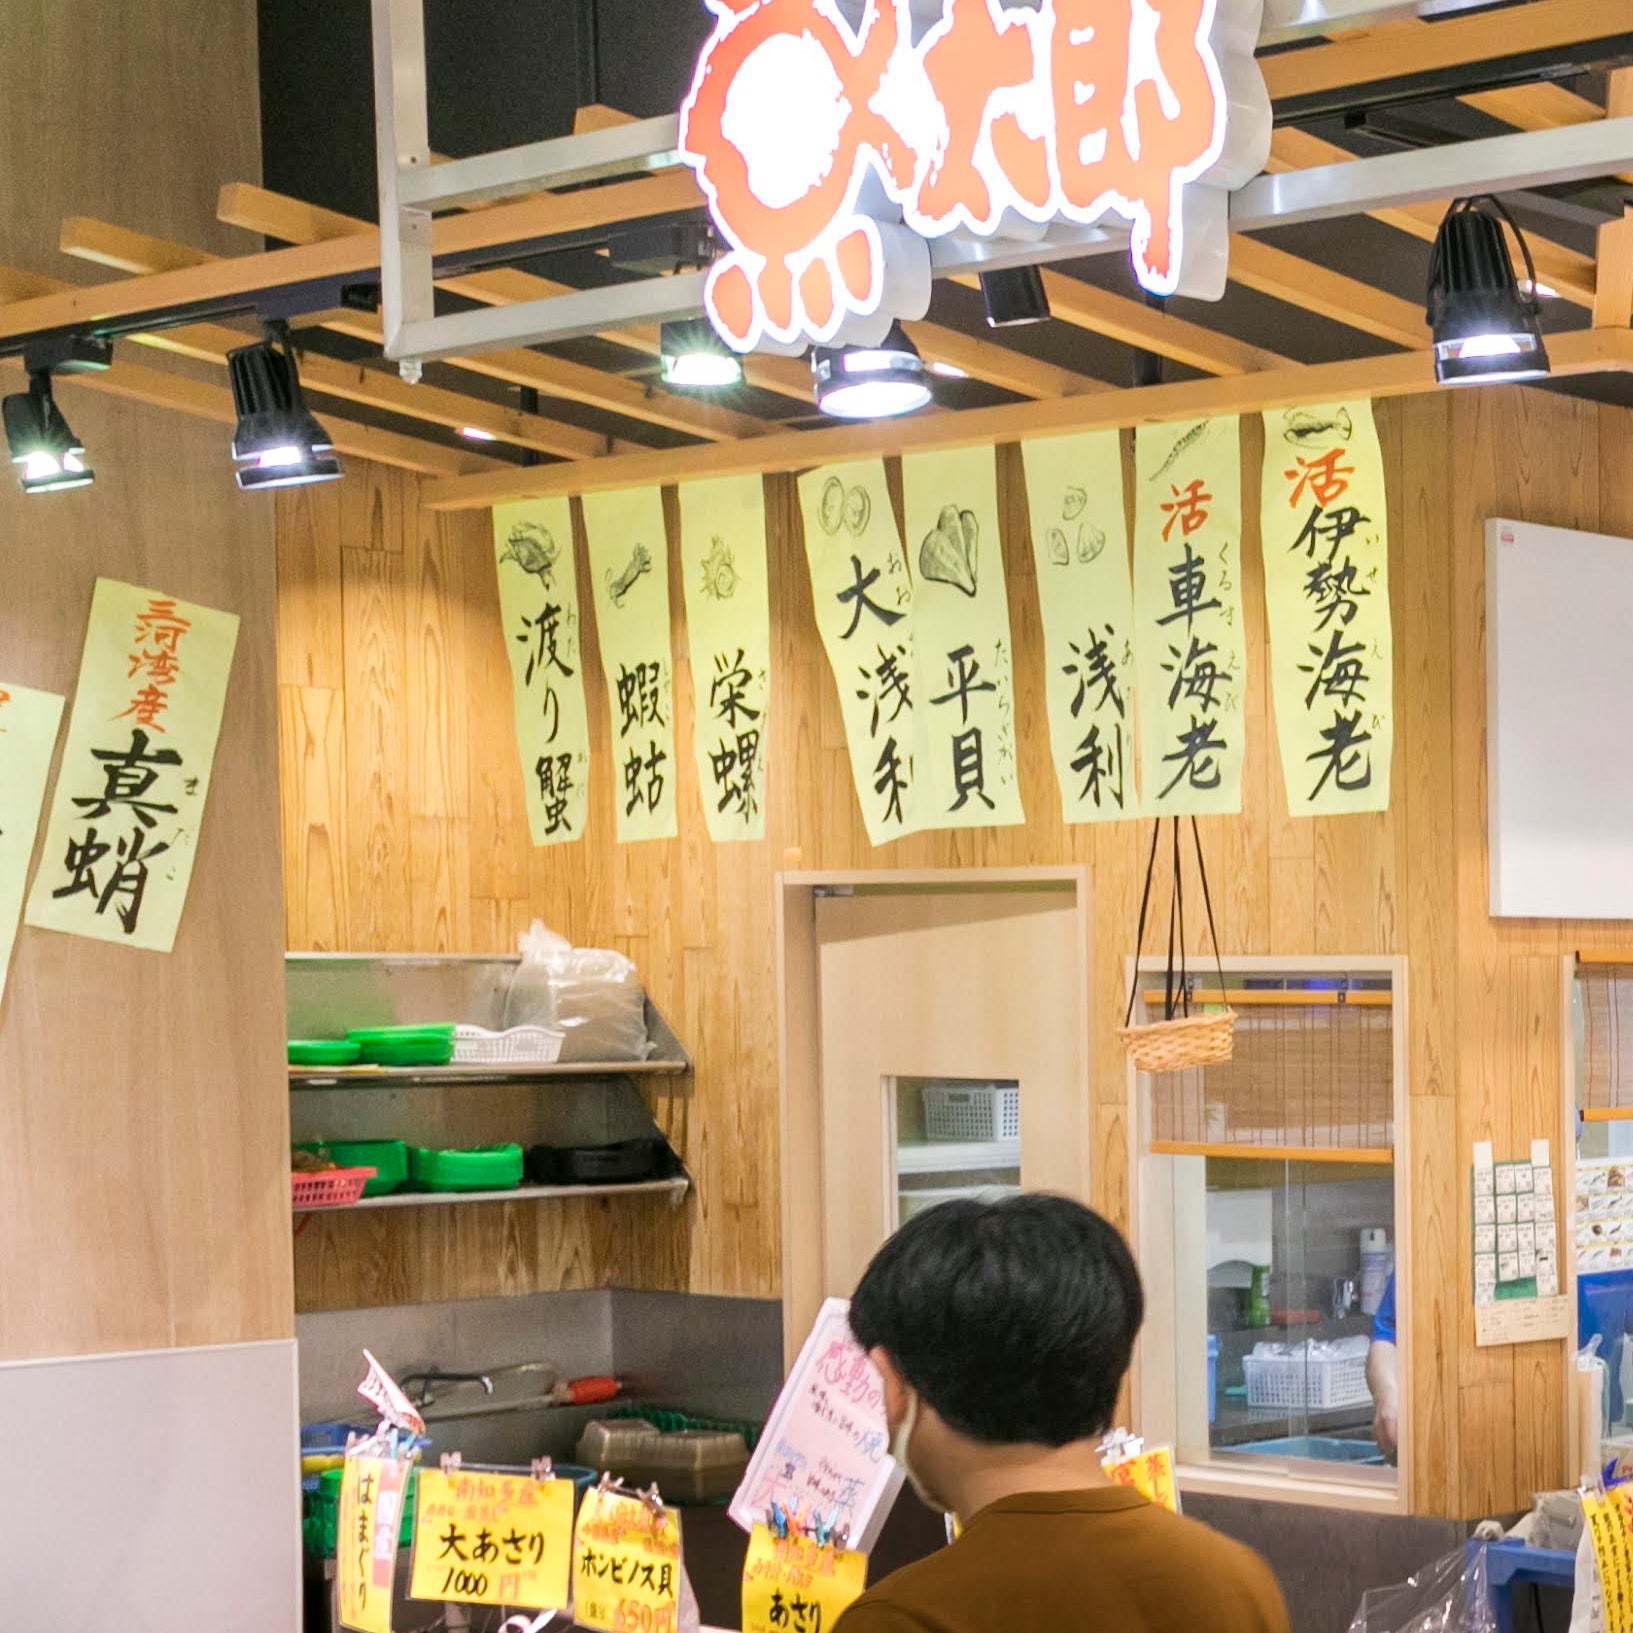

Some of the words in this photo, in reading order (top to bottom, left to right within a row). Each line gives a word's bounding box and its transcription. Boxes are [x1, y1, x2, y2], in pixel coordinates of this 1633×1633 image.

[109, 600, 192, 734] 三河湾産
[515, 602, 575, 836] 渡り蟹
[616, 661, 668, 817] 蝦蛄
[708, 648, 761, 825] 栄螺
[836, 554, 912, 824] 大浅利
[929, 645, 997, 813] 平貝
[1061, 624, 1125, 810] 浅利
[52, 727, 184, 936] 真蛸
[357, 1473, 374, 1611] はまぐり
[437, 1522, 545, 1565] 大あさり
[581, 1548, 674, 1600] ホンビノス貝
[769, 1585, 822, 1633] あさり
